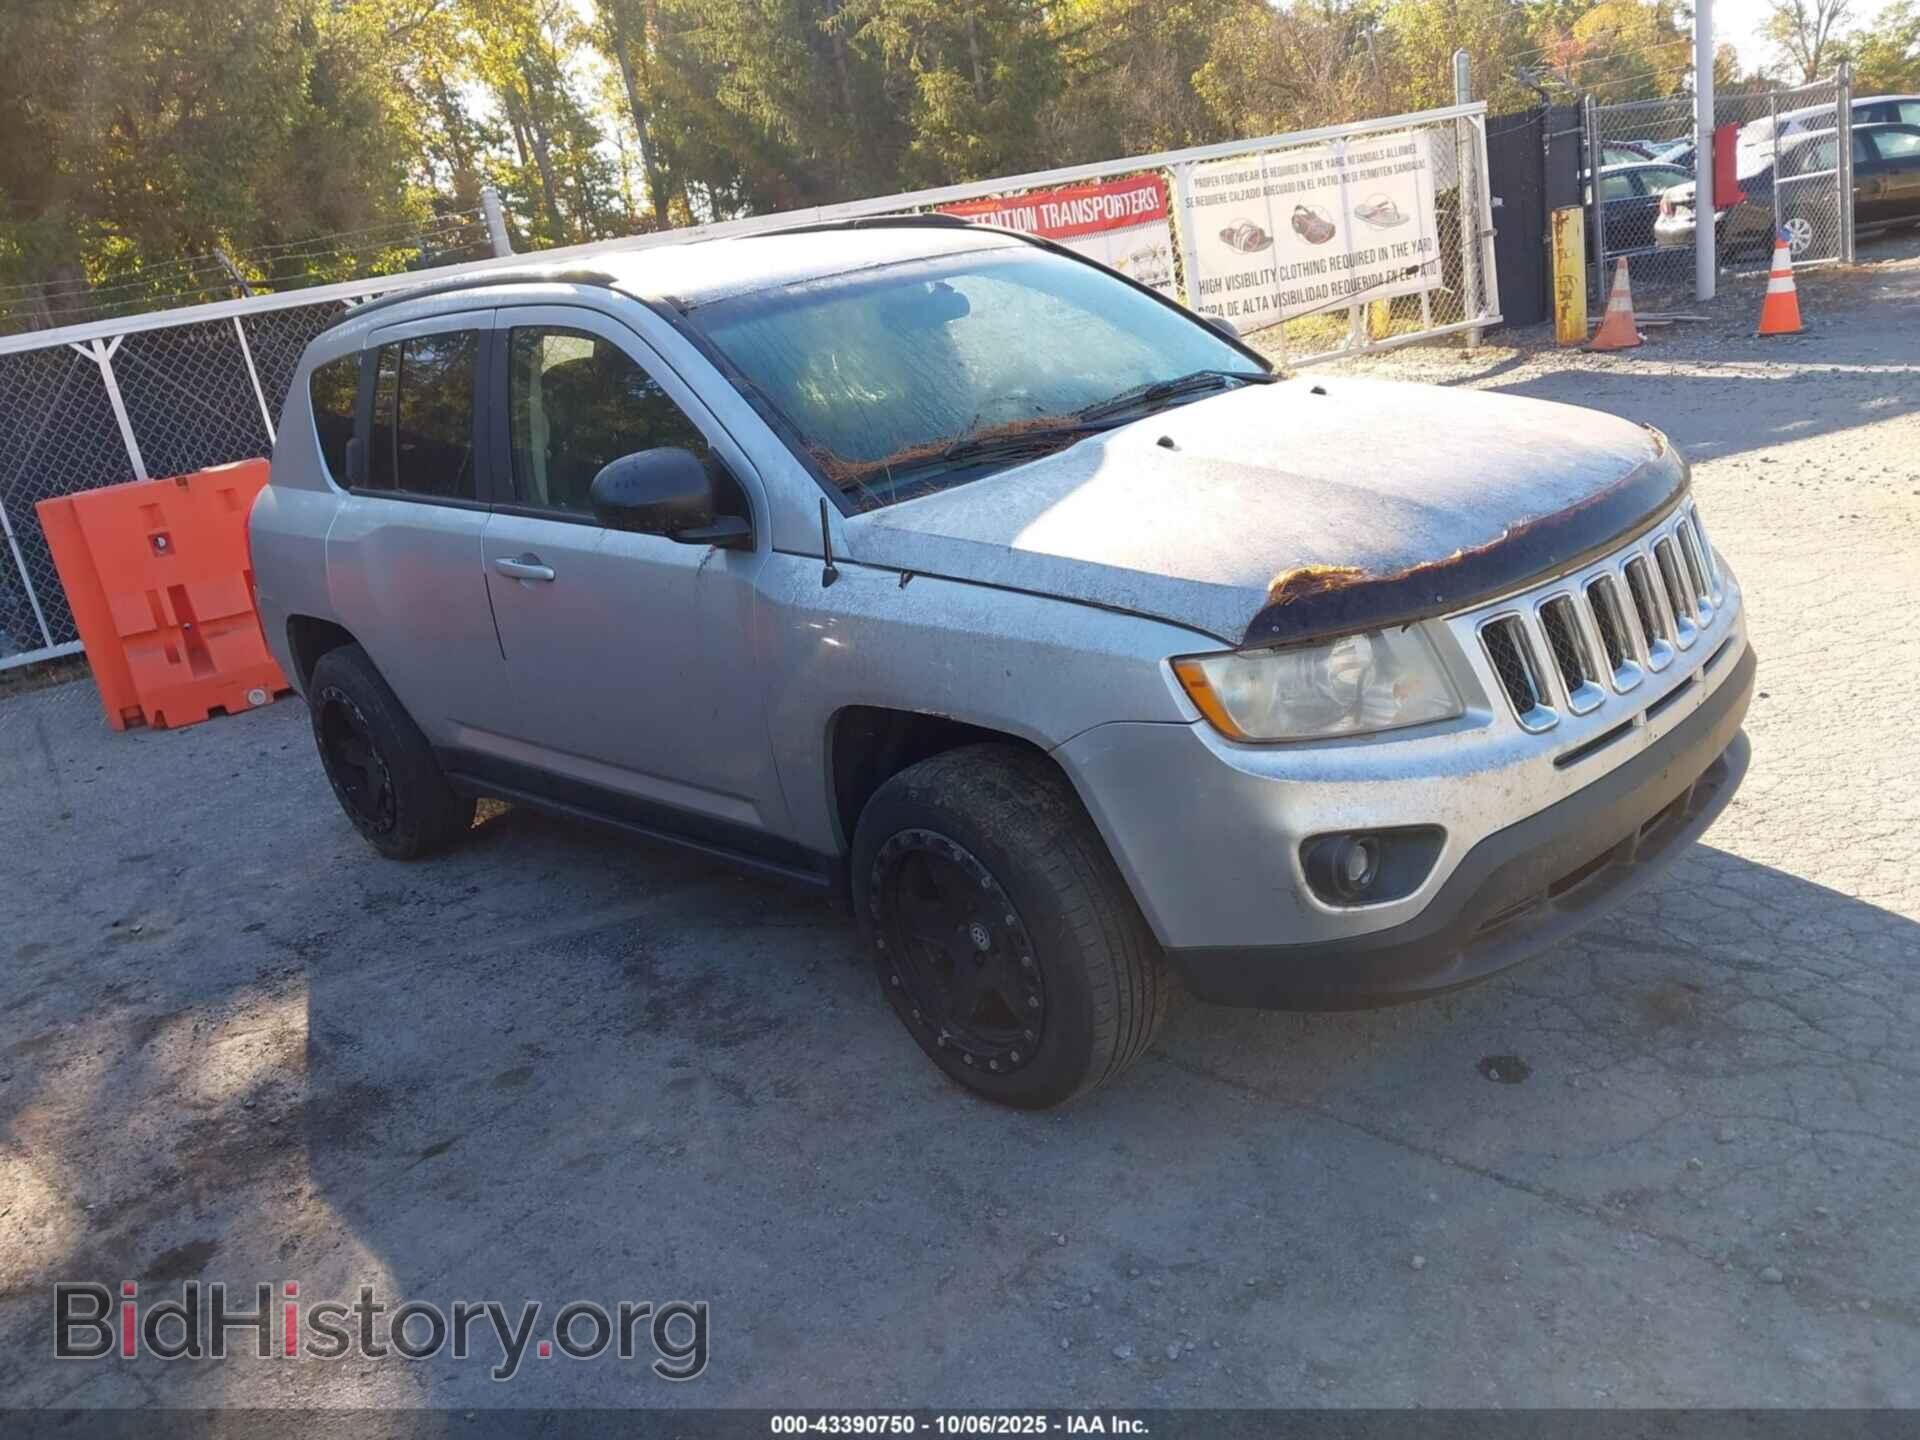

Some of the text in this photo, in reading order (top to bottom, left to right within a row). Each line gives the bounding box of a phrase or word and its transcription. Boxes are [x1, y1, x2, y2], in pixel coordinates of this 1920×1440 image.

[1185, 197, 1194, 208] SE
[1229, 187, 1261, 202] CALZADO
[1297, 180, 1306, 191] EN
[1307, 179, 1315, 190] EL
[1221, 170, 1259, 186] FOOTWEAR
[1301, 163, 1308, 173] IN
[1310, 160, 1323, 172] THE
[1041, 186, 1159, 229] TRANSPORTERS!
[1198, 277, 1222, 296] HIGH
[1225, 267, 1277, 291] VISIBILITY
[1280, 258, 1327, 281] CLOTHING
[1329, 248, 1376, 272] REQUIRED
[1378, 246, 1388, 260] IN
[1391, 241, 1408, 258] THE
[1227, 300, 1240, 316] DE
[1243, 295, 1269, 314] ALTA
[1271, 283, 1328, 308] VISIBILIDAD
[1331, 271, 1384, 297] REQUERIDA
